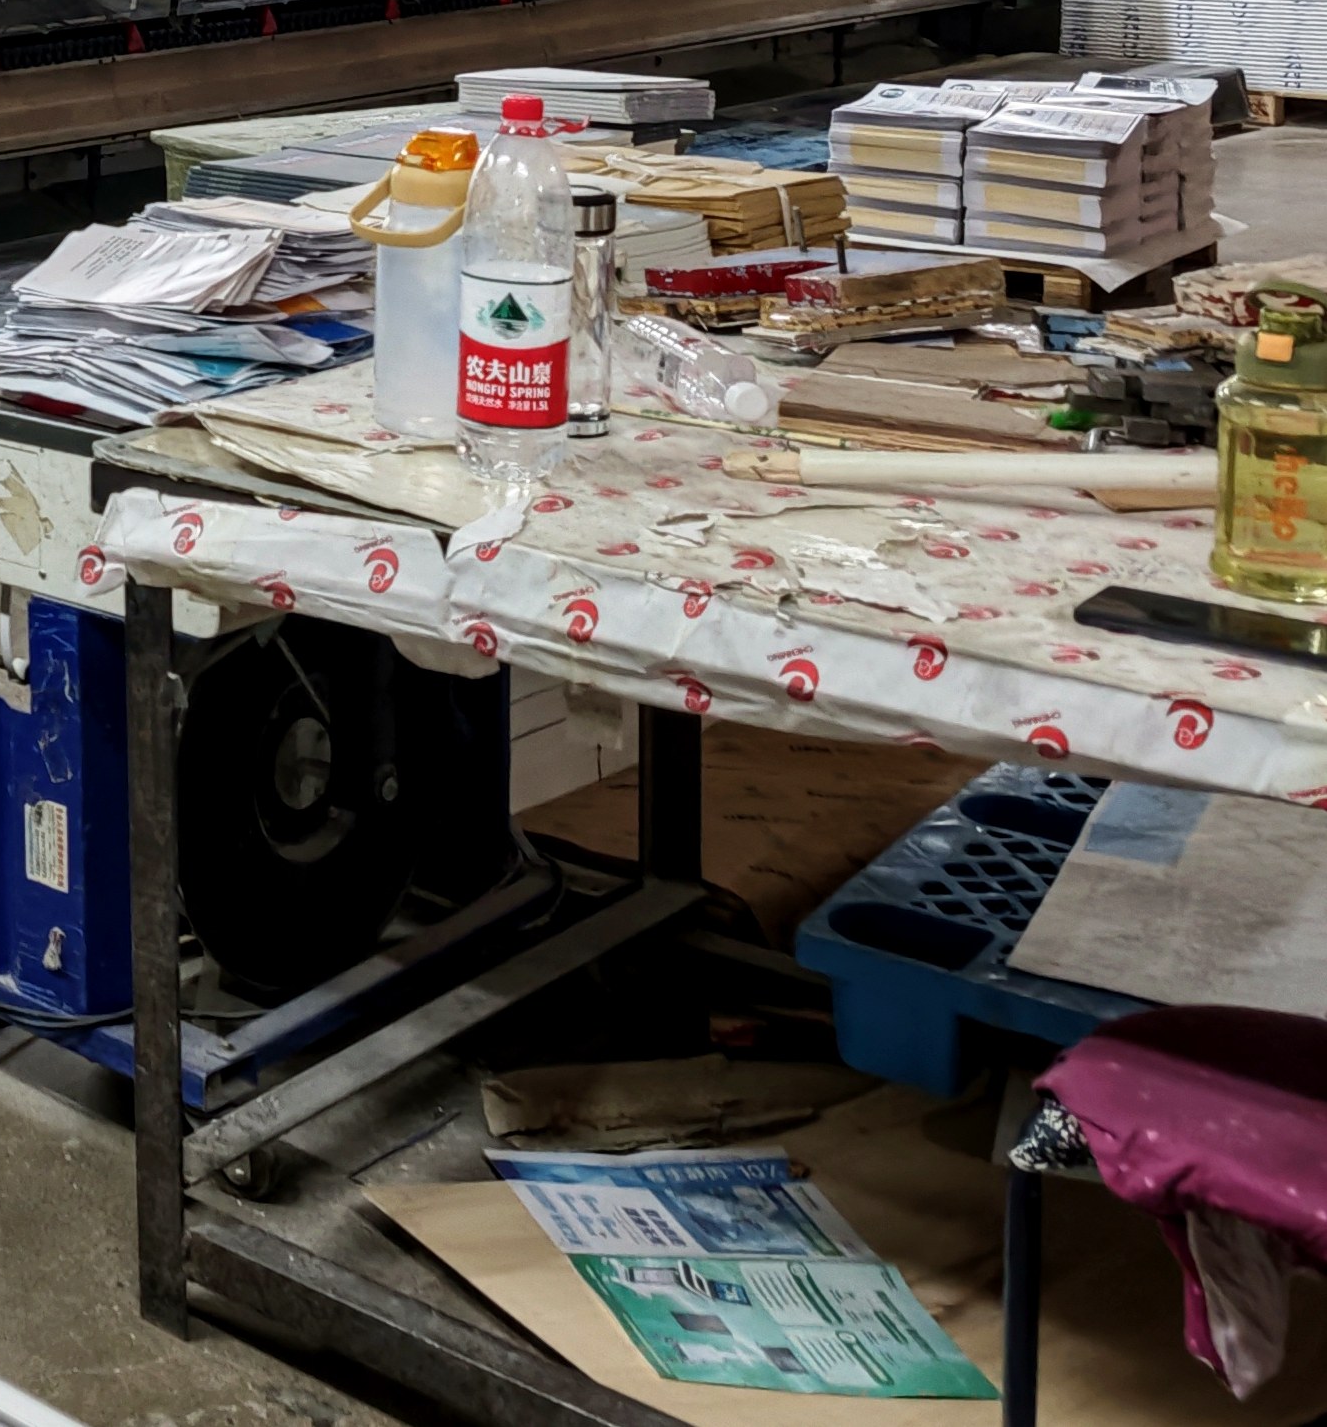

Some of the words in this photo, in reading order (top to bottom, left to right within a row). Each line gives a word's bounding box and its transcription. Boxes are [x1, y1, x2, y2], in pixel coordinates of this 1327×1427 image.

[466, 353, 552, 386] 农夫山泉
[466, 378, 507, 398] NONGFU
[509, 385, 551, 400] SPRING
